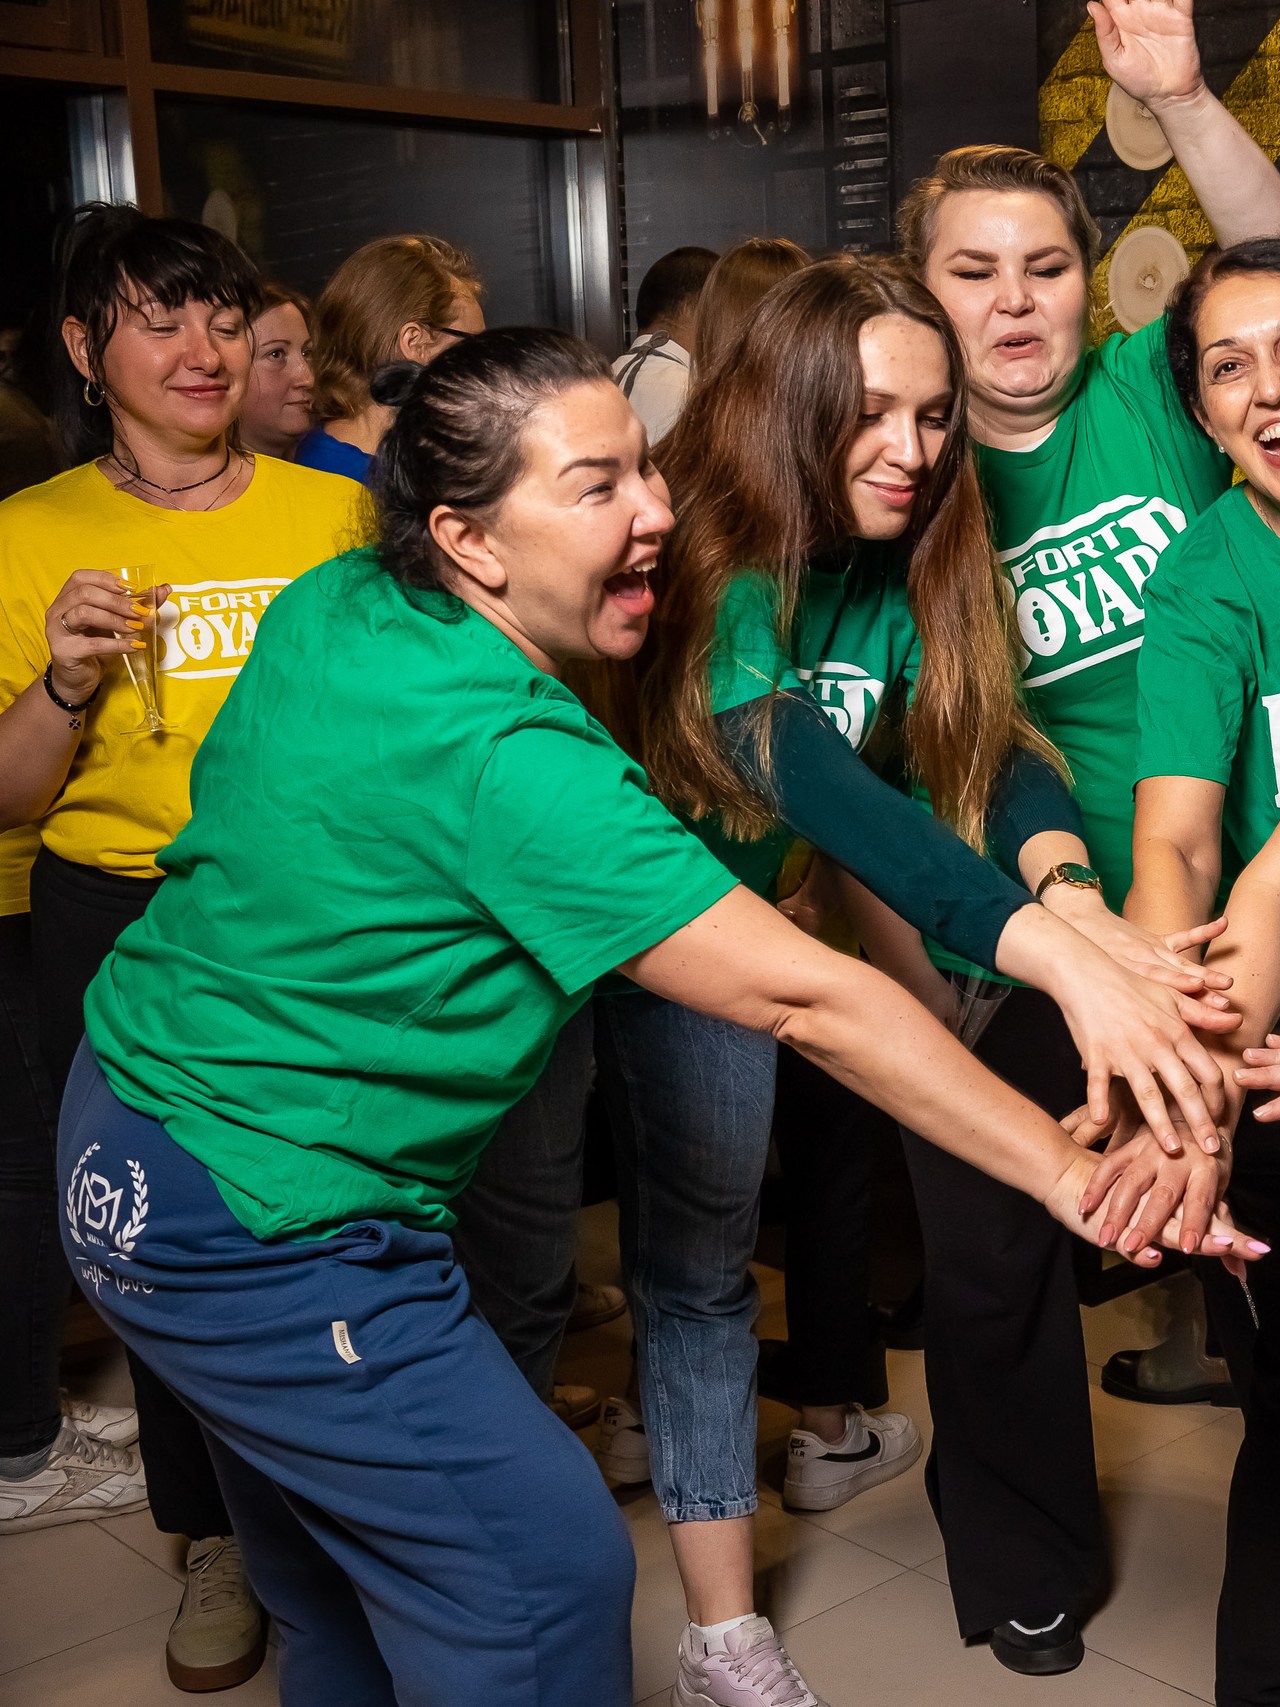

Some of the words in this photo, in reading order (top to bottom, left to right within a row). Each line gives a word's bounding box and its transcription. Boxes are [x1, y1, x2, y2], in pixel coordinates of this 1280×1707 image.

[1001, 496, 1188, 674] OYARD
[1011, 520, 1120, 588] FORT
[155, 600, 261, 671] BOYA
[179, 590, 274, 612] FORT
